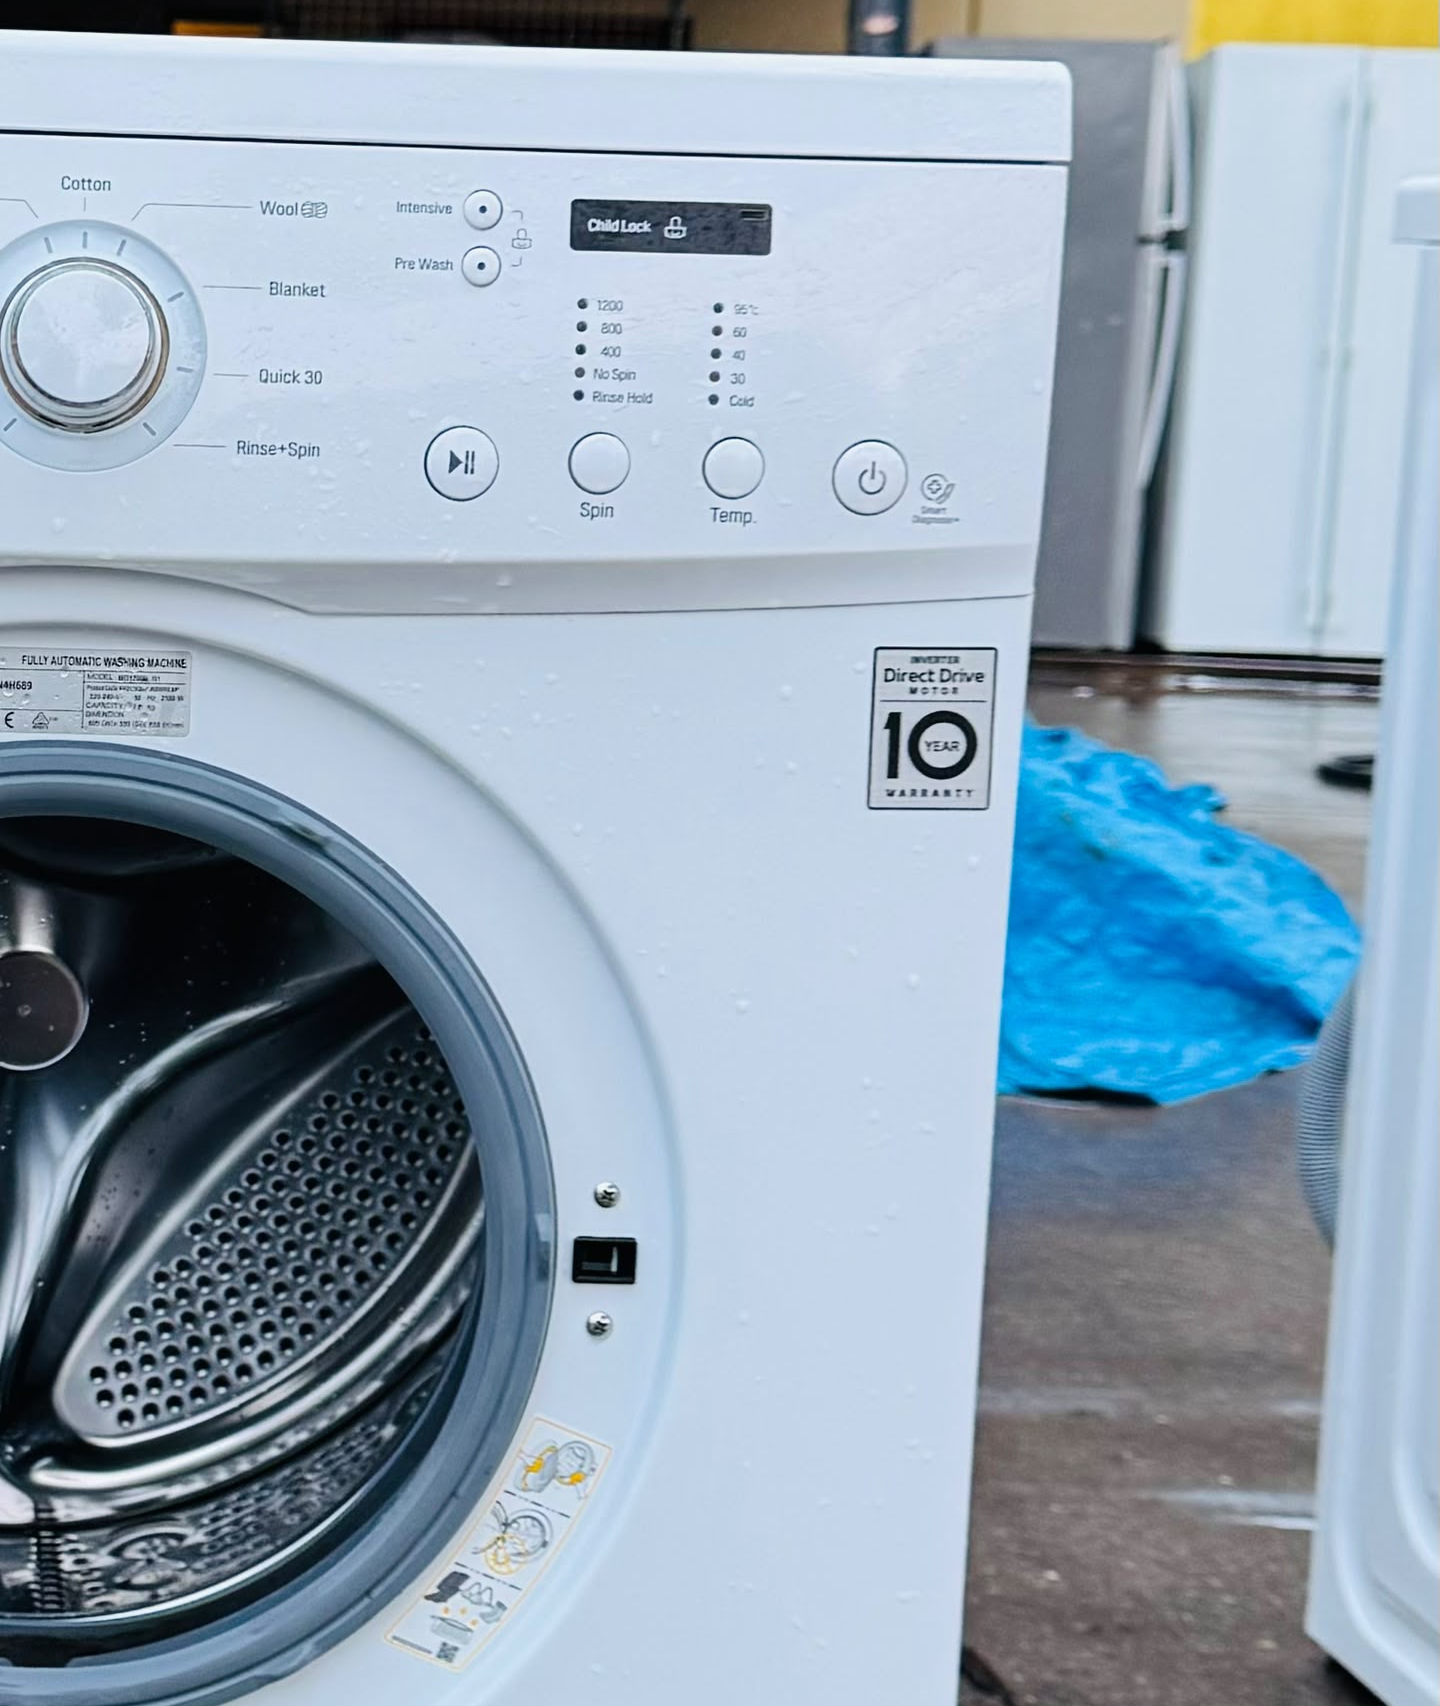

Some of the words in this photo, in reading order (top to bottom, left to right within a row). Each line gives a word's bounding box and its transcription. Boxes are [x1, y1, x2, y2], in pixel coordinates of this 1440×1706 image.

[61, 175, 111, 192] Cotton
[259, 200, 299, 217] Wool
[396, 200, 453, 215] Intensive
[587, 217, 620, 233] Child
[621, 219, 652, 234] Lock
[394, 257, 417, 270] Pre
[419, 257, 454, 271] Wash
[269, 281, 326, 299] Blanket
[258, 367, 300, 386] Quick
[304, 368, 323, 386] 30
[593, 368, 610, 381] No
[611, 368, 637, 382] Spin
[592, 390, 624, 403] Rinse
[626, 391, 653, 404] Hold
[729, 395, 755, 408] Cold
[237, 440, 321, 459] Rinse+Spin
[579, 501, 614, 521] Spin
[710, 507, 756, 528] Temp.
[22, 654, 49, 666] FULLY
[50, 655, 101, 667] AUTOMATIC
[103, 656, 145, 668] WASHING
[146, 657, 187, 669] MACHINE
[910, 655, 961, 665] INVERTER
[883, 667, 935, 683] Direct
[939, 669, 985, 684] Drive
[908, 686, 960, 696] MOTOR
[883, 709, 978, 781] 10
[924, 740, 961, 752] YEAR
[885, 788, 976, 798] WARRANTY
